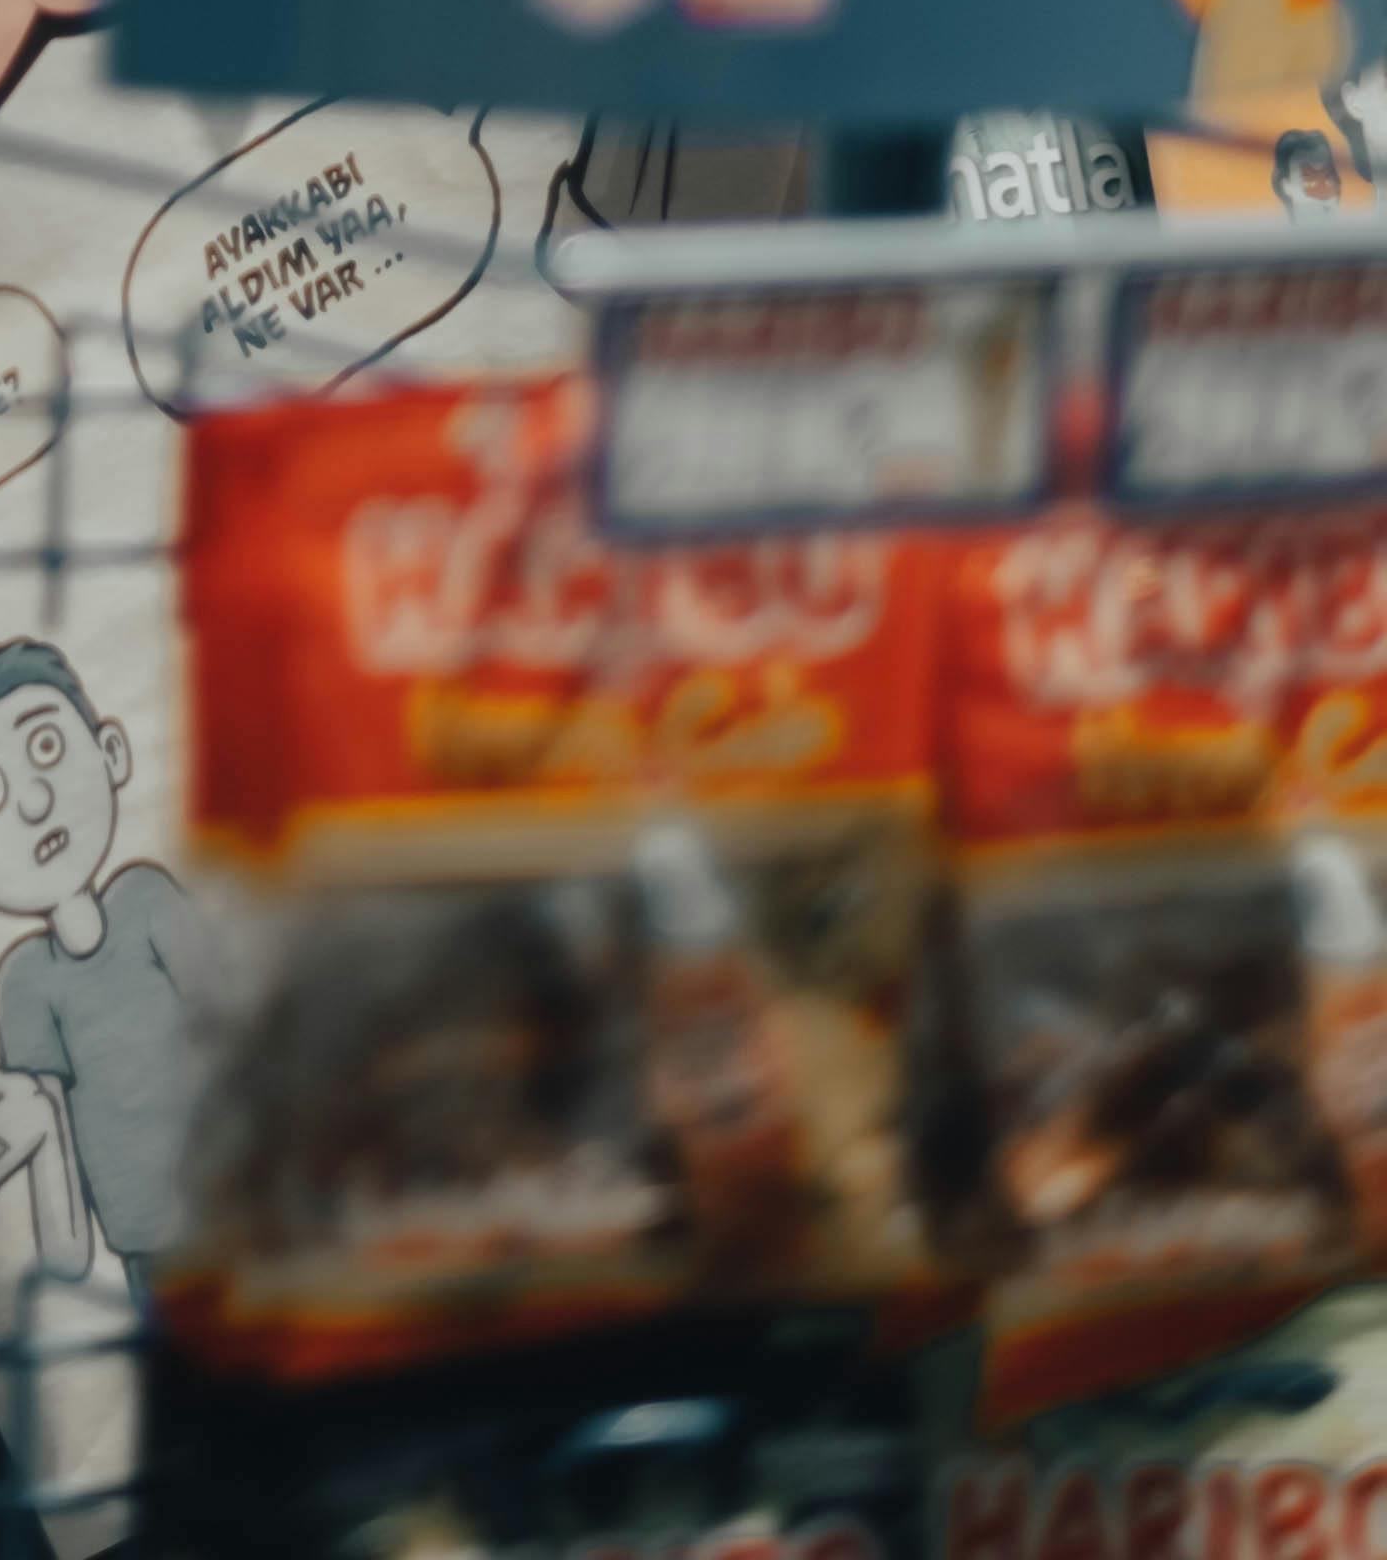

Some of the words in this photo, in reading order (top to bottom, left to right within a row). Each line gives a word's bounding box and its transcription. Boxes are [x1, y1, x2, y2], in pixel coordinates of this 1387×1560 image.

[201, 238, 320, 333] ALDIM
[325, 198, 408, 259] YAA,
[205, 152, 365, 279] AYAKKABI
[235, 309, 284, 360] NE
[289, 262, 365, 322] VAR
